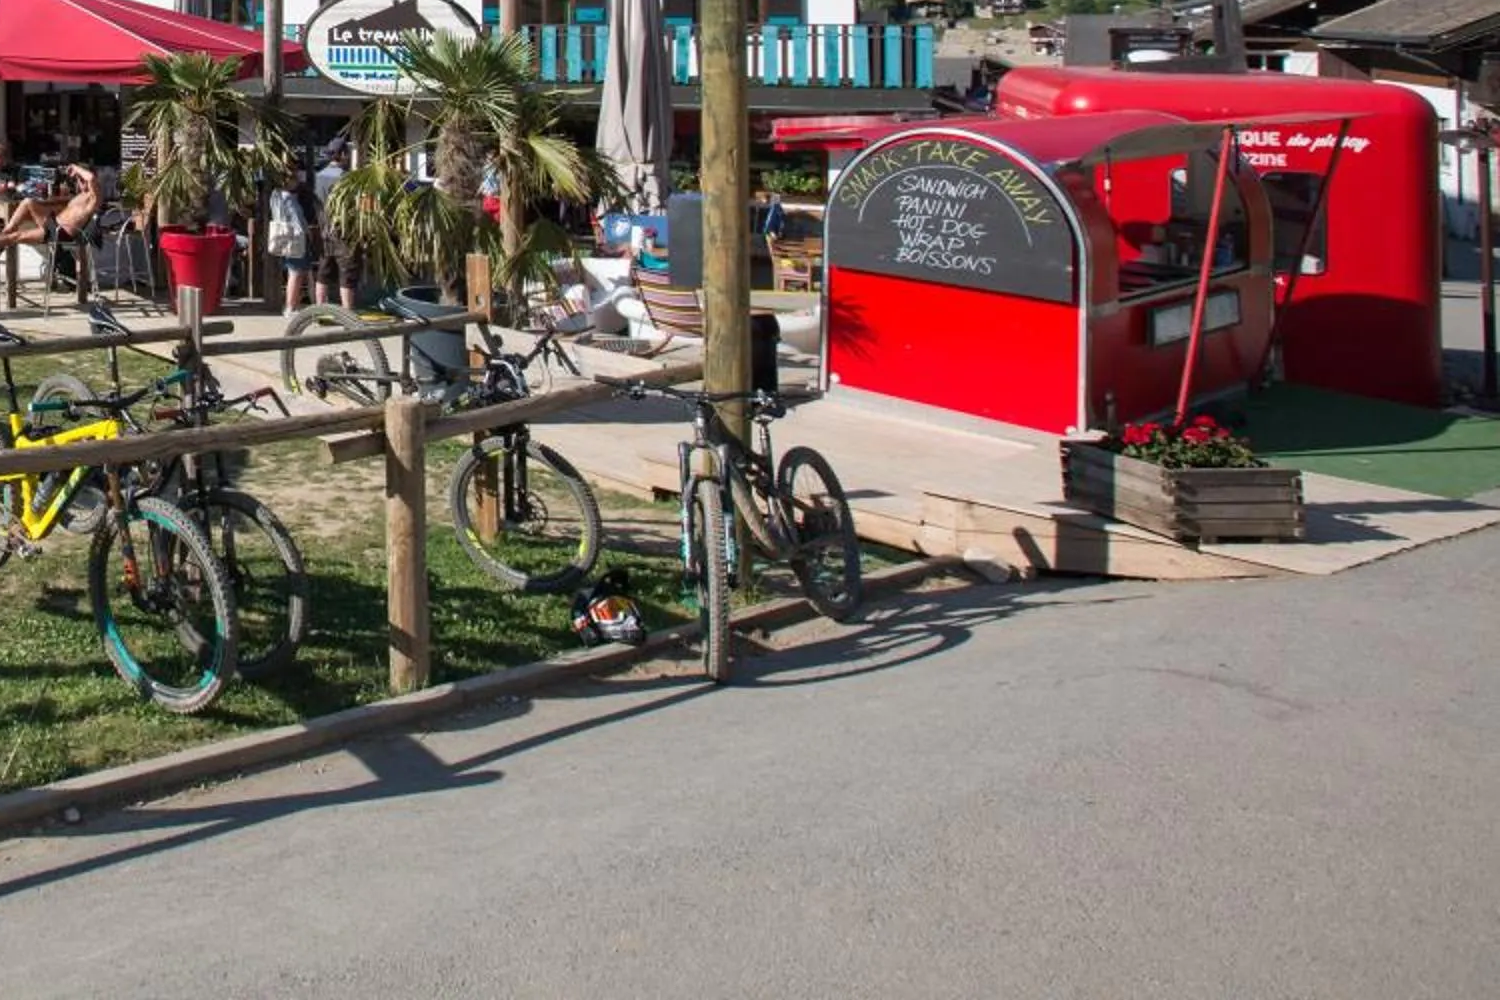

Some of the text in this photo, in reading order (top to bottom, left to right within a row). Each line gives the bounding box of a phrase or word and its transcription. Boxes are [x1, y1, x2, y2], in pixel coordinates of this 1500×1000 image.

[333, 28, 353, 43] Le
[896, 195, 967, 219] PANINI
[986, 168, 1052, 226] AWAY
[900, 230, 966, 251] WRAP
[896, 247, 997, 275] BOISSONS
